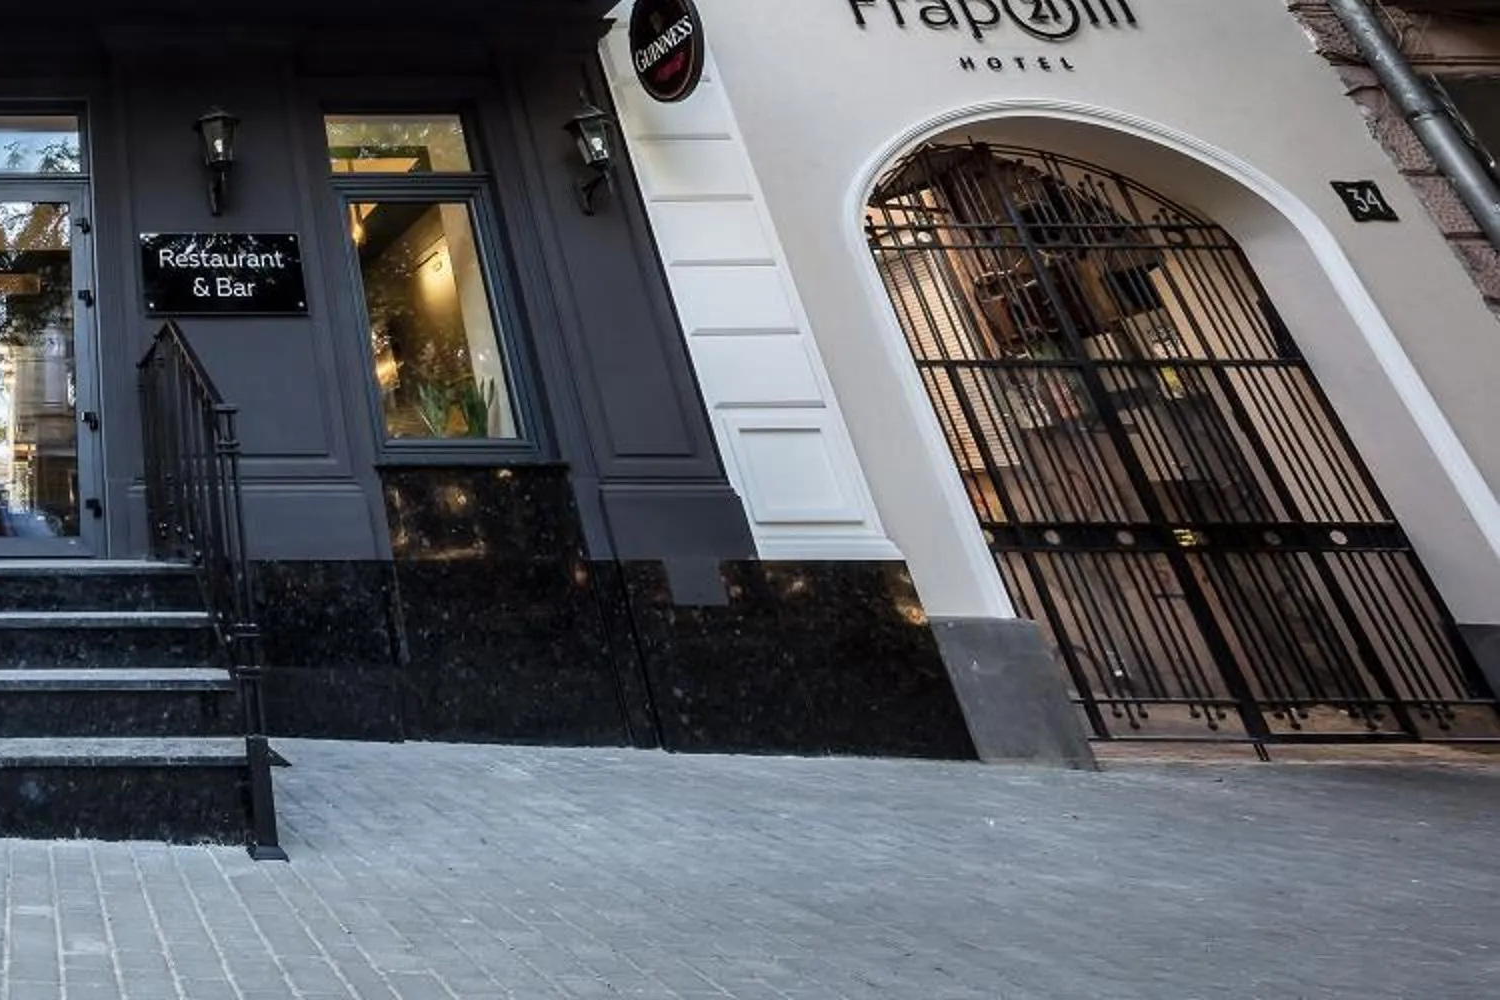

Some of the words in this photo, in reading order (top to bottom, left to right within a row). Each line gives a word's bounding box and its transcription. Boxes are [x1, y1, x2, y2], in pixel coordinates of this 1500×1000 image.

[635, 14, 693, 73] GUINNESS
[959, 56, 1077, 73] HOTEL
[1345, 187, 1385, 213] 34
[158, 249, 285, 269] Restaurant
[192, 277, 211, 298] &
[216, 277, 256, 298] Bar
